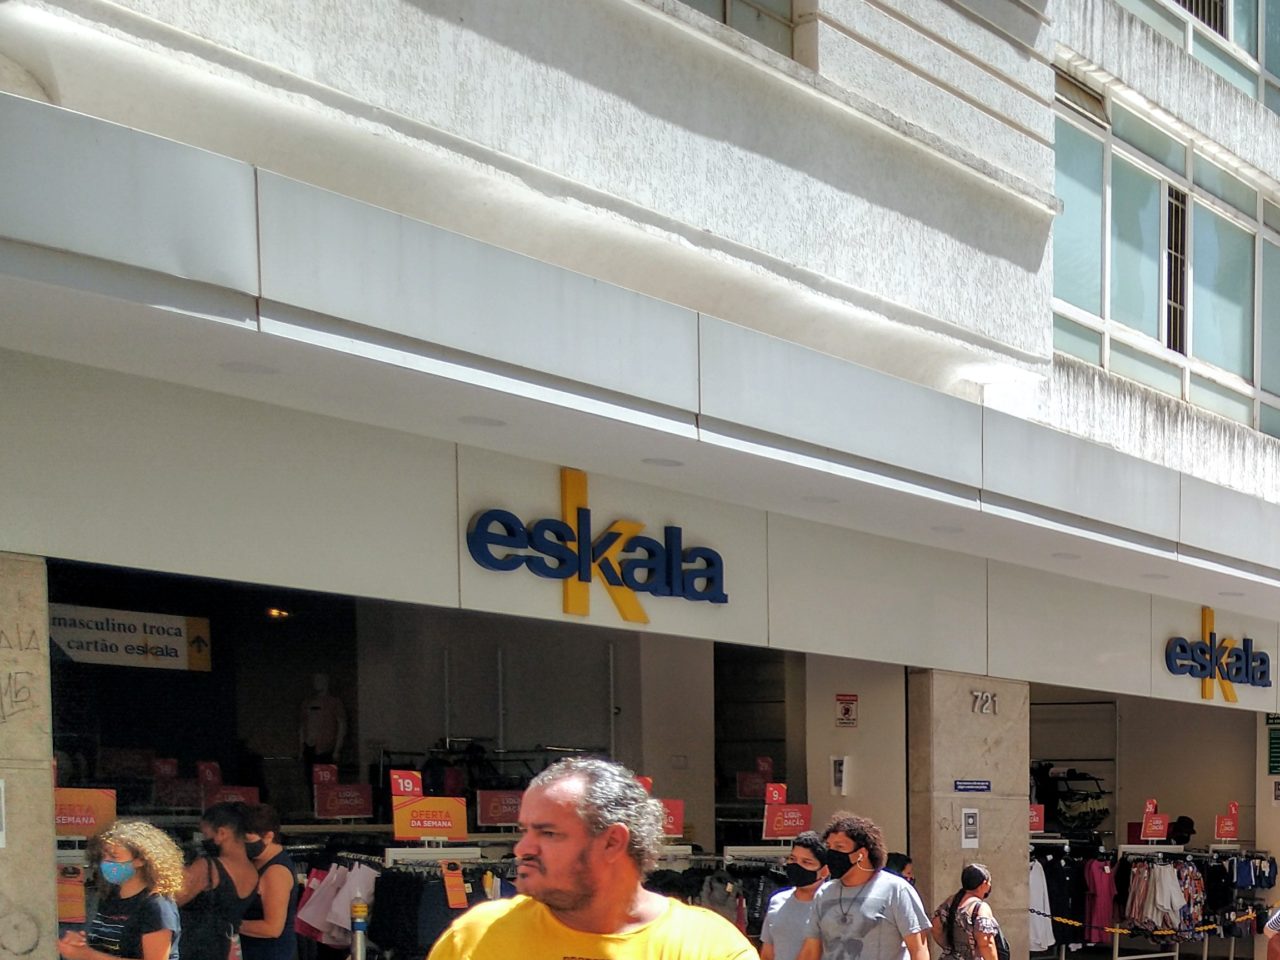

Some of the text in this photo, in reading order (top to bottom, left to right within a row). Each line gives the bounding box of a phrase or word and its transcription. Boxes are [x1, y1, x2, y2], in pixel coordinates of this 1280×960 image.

[466, 466, 729, 623] eskala
[52, 614, 183, 637] masculino troca
[67, 638, 180, 661] cartão eskala
[1165, 605, 1272, 703] eskala
[970, 691, 999, 715] 721
[398, 778, 414, 793] 19
[772, 790, 779, 801] 9
[411, 810, 451, 819] OFERTA
[423, 820, 452, 828] SEMANA
